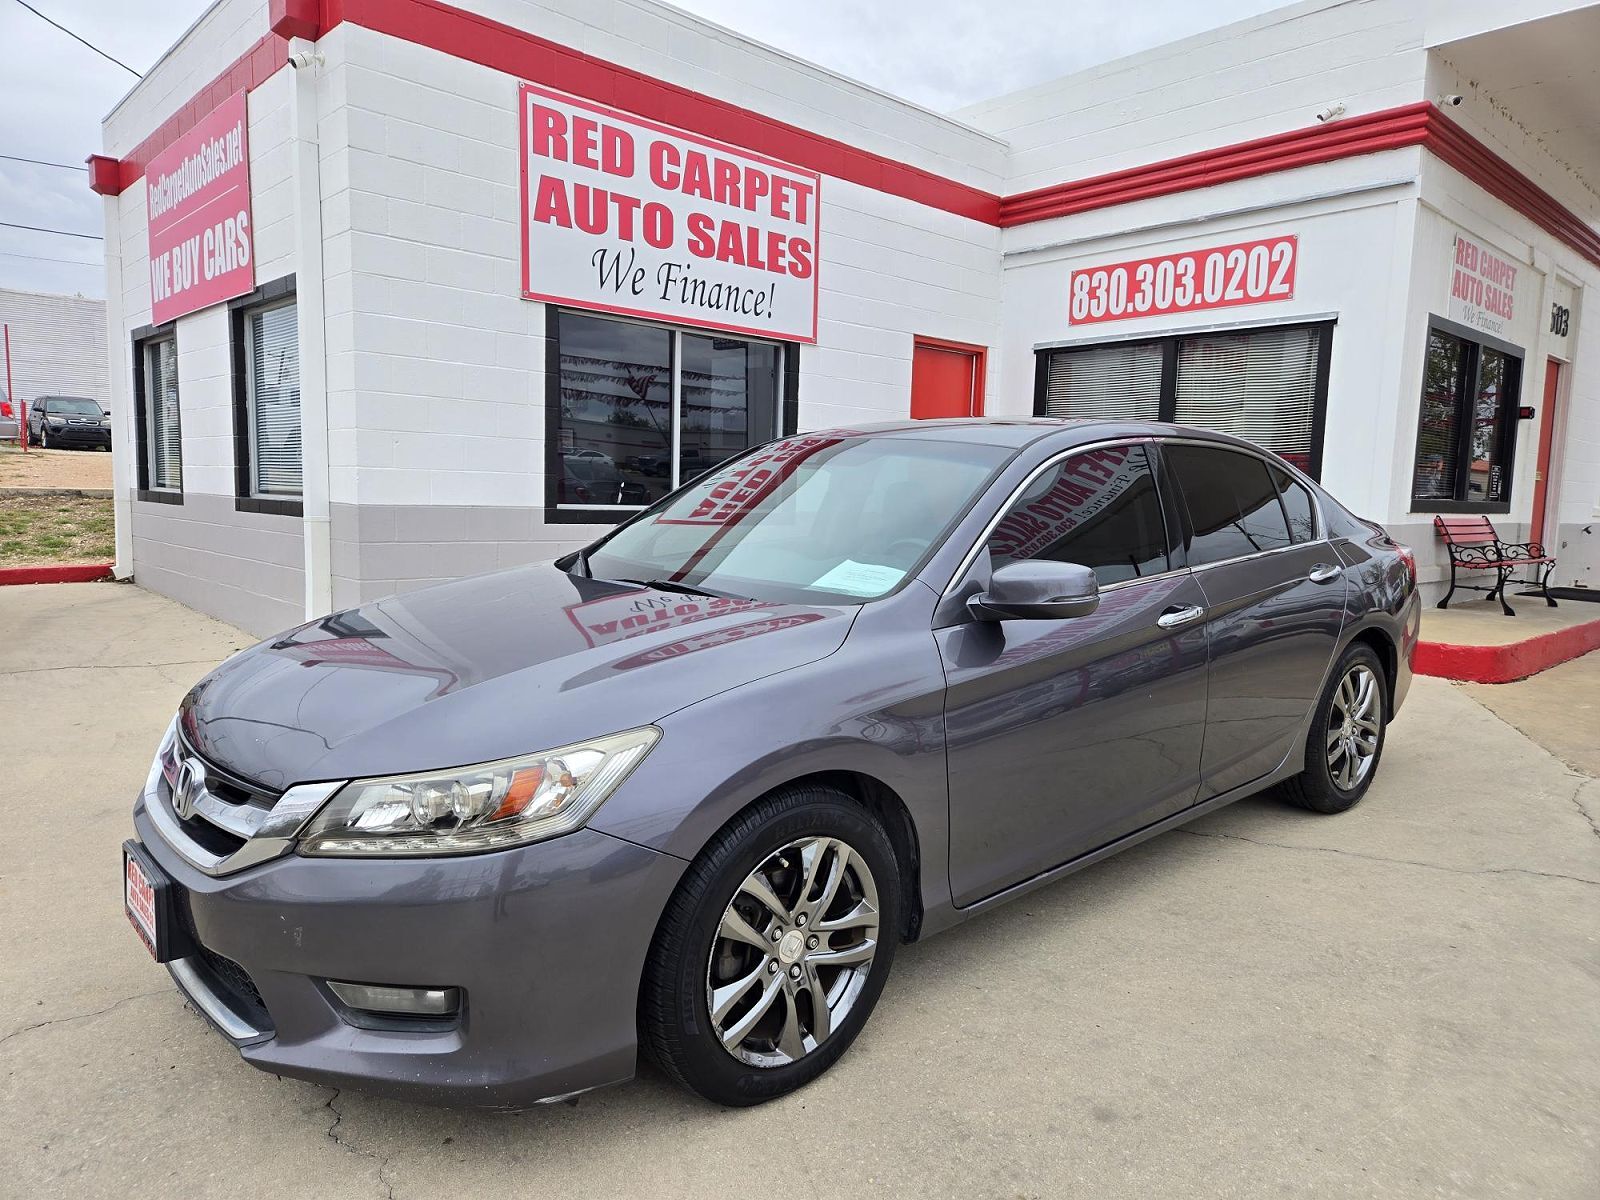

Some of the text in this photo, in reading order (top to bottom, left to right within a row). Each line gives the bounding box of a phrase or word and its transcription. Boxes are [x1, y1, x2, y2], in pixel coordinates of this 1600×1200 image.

[149, 120, 243, 221] RedCarpetAutoSales.net
[532, 102, 813, 225] RED CARPET
[151, 210, 250, 303] WE BUY CARS
[533, 174, 812, 279] AUTO SALES
[1455, 237, 1517, 291] RED CARPET
[591, 247, 776, 318] We Finance!
[1072, 241, 1293, 320] 830.303.0202
[1452, 269, 1514, 320] AUTO SALES
[1550, 302, 1570, 337] 503
